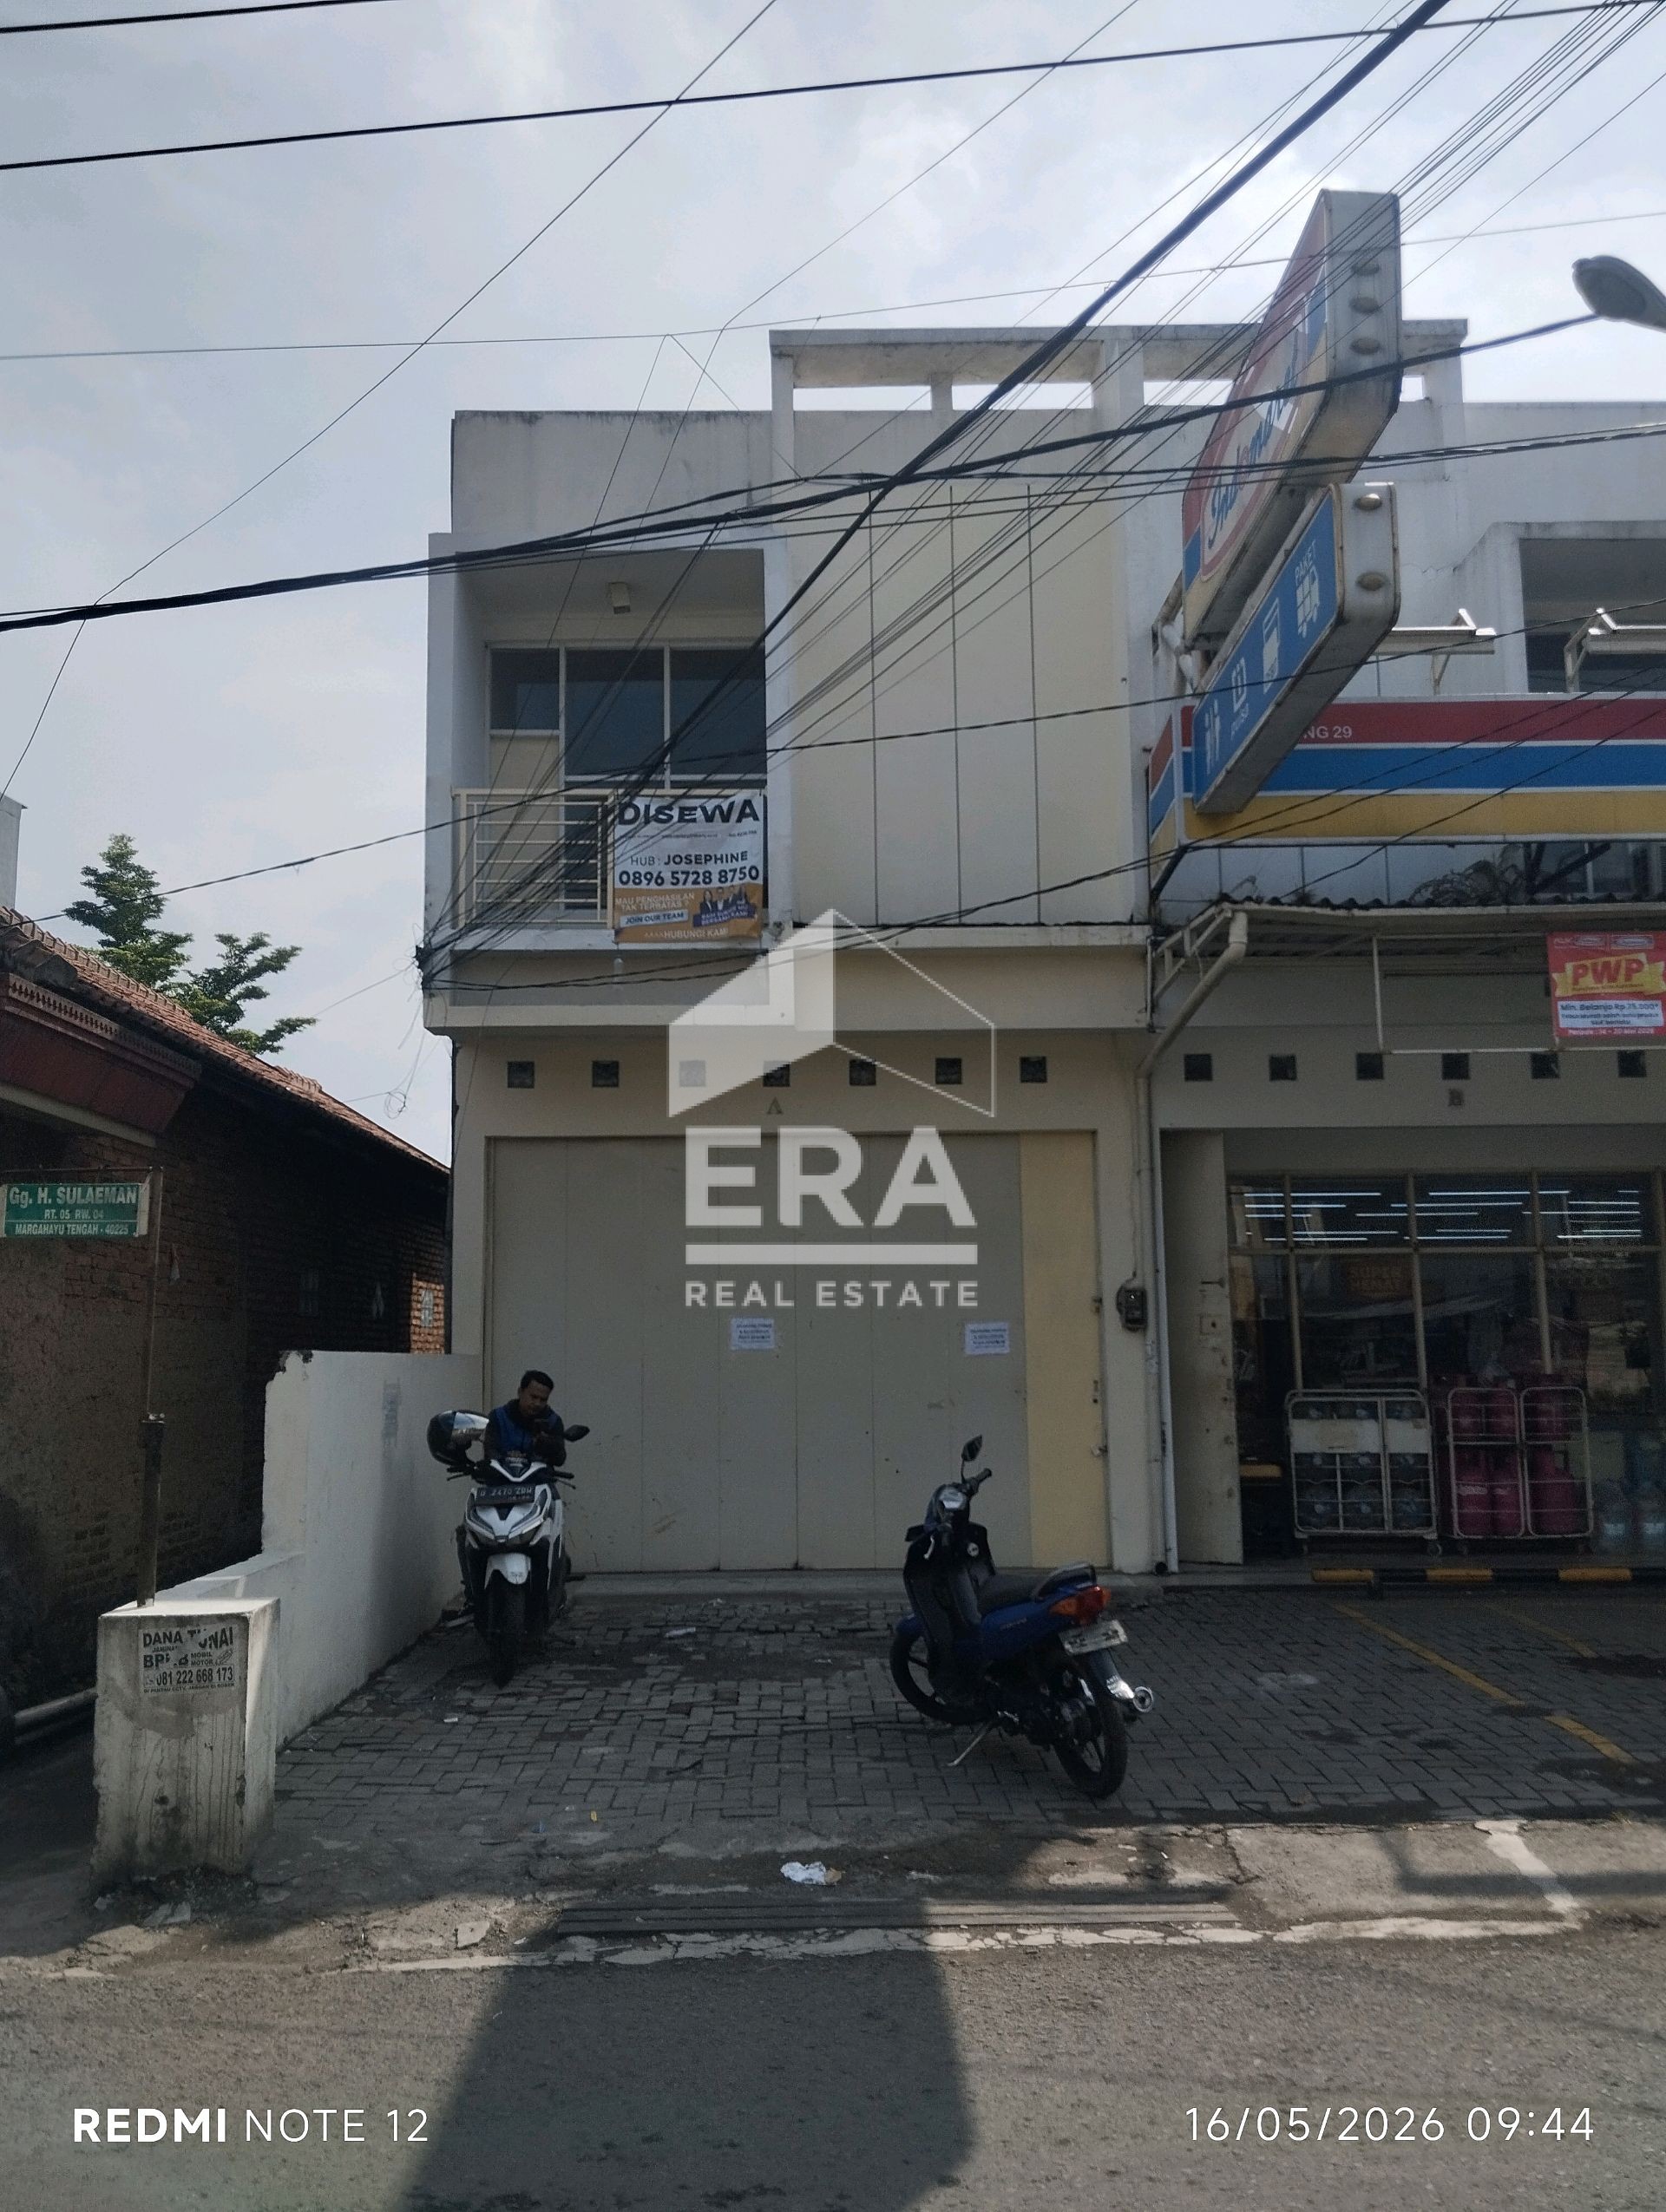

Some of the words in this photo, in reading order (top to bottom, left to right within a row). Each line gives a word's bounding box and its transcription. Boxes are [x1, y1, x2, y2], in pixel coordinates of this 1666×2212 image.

[1333, 725, 1353, 738] 29
[617, 799, 760, 825] DISEWA
[664, 850, 748, 866] JOSEPHINE
[619, 870, 666, 887] 0896
[670, 870, 712, 886] 5728
[718, 865, 759, 884] 8750
[625, 916, 643, 925] JOIN
[662, 913, 685, 921] TEAM
[1571, 958, 1645, 986] PWP
[10, 1187, 32, 1208] Gg.
[37, 1188, 52, 1204] H.
[56, 1187, 137, 1204] SULAEMAN
[44, 1209, 57, 1220] RT.
[60, 1209, 70, 1220] 05
[75, 1209, 90, 1220] RW.
[15, 1224, 64, 1235] MARGAHAYU
[67, 1224, 99, 1234] TENGAH
[143, 1630, 183, 1647] DANA
[176, 1670, 193, 1685] 222
[196, 1668, 213, 1682] 668
[217, 1666, 233, 1681] 173
